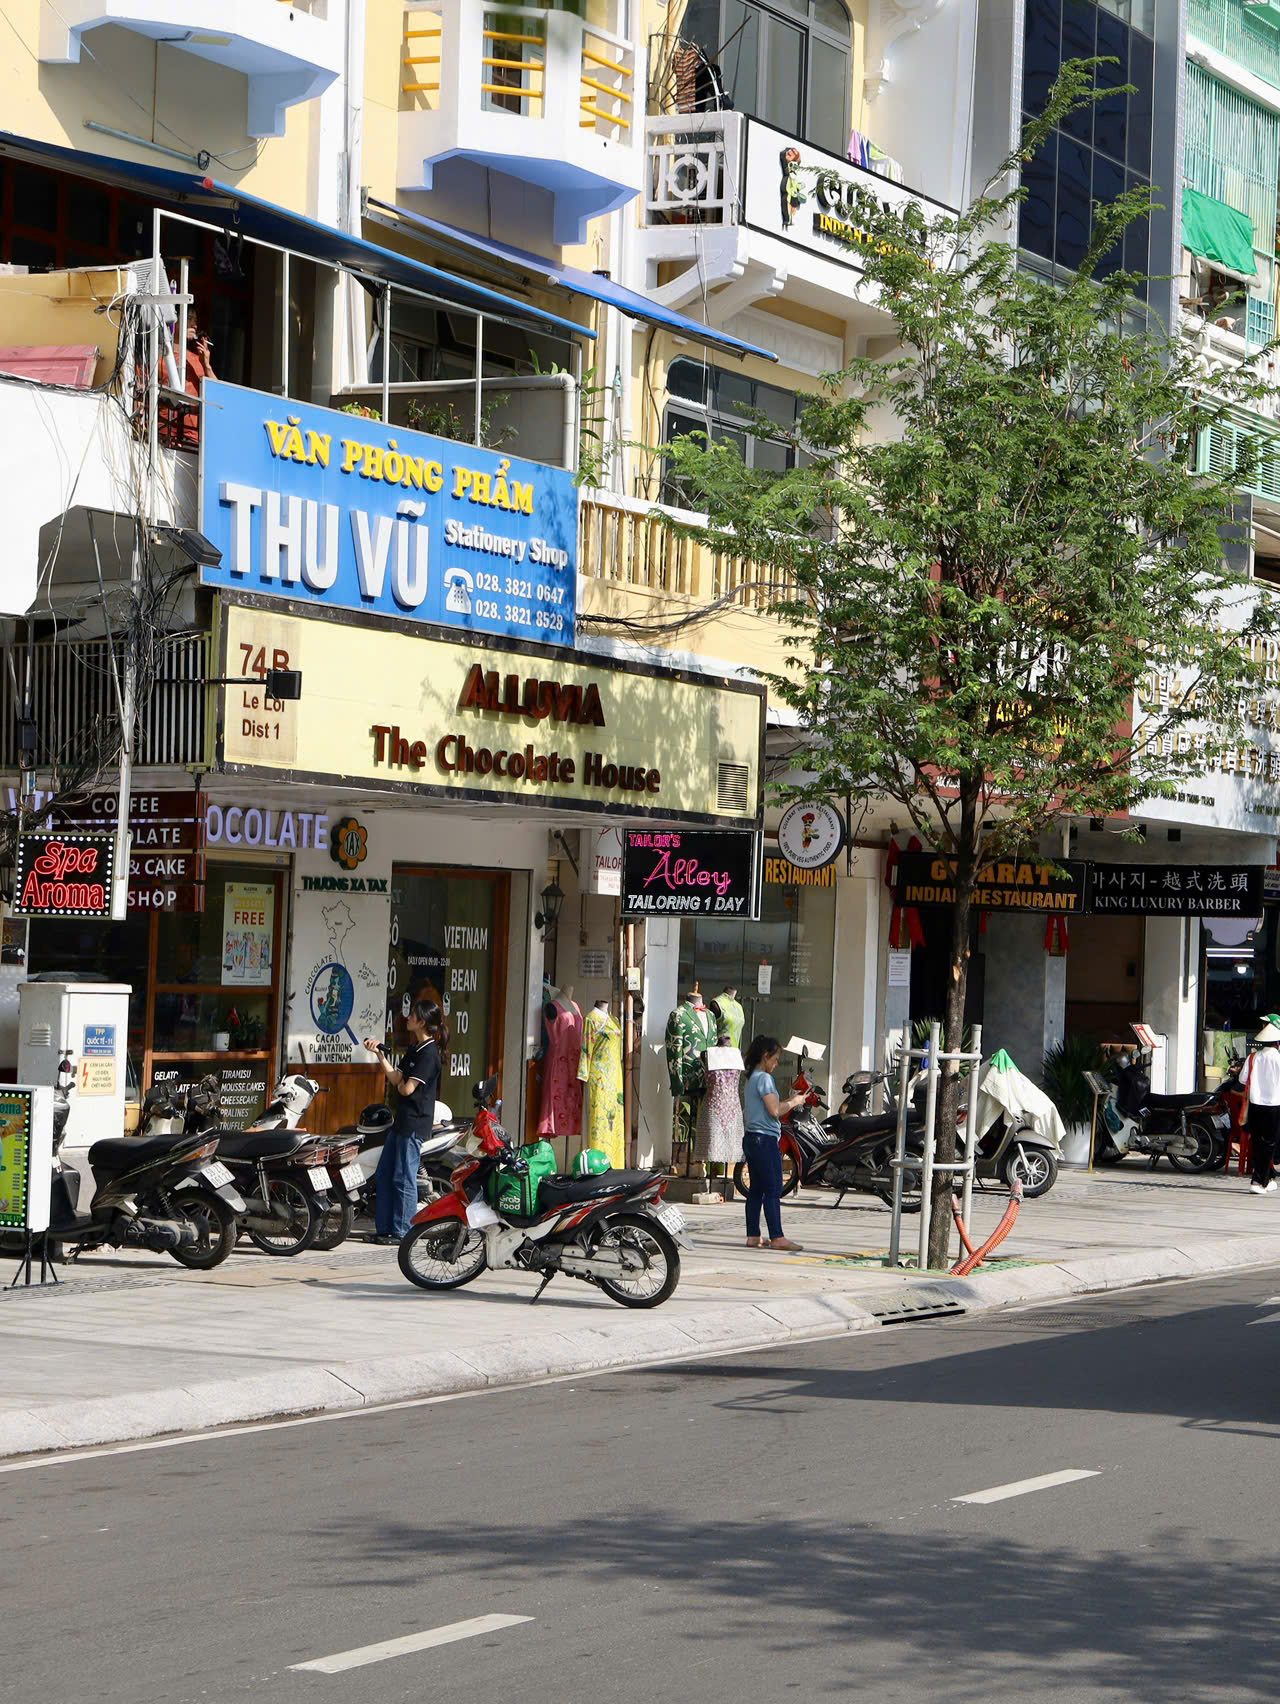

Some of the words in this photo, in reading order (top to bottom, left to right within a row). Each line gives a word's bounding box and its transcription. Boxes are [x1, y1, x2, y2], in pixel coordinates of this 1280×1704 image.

[818, 213, 863, 244] INDIAN
[264, 416, 331, 467] VĂN
[341, 440, 443, 494] PHÒNG
[452, 460, 535, 515] PHẨM
[219, 481, 340, 592] THU
[351, 500, 430, 608] VŨ
[445, 519, 527, 562] Stationery
[529, 537, 568, 571] Shop
[476, 571, 502, 593] 028.
[505, 577, 533, 599] 3821
[536, 583, 565, 605] 0647
[475, 599, 501, 620] 028.
[504, 604, 532, 627] 3821
[535, 612, 564, 632] 8528
[243, 690, 259, 709] Le
[242, 719, 269, 738] Dist
[274, 723, 280, 740] 1
[371, 725, 426, 768] The
[437, 735, 575, 784] Chocolate
[584, 752, 661, 794] House
[91, 797, 159, 814] COFEE
[628, 833, 681, 848] TAILOR'S
[34, 841, 98, 880] Spa
[145, 859, 185, 875] CAKE
[643, 848, 731, 895] Alley
[765, 858, 836, 887] RESTAURANT
[20, 871, 104, 910] Aroma
[366, 880, 388, 893] TAX
[627, 894, 701, 911] TAILORING
[704, 896, 711, 910] 1
[714, 897, 745, 912] DAY
[970, 889, 1077, 908] RESTAURANT
[1095, 896, 1128, 908] KING
[1131, 897, 1184, 909] LUXURY
[1188, 898, 1241, 910] BARBER
[234, 911, 264, 925] FREE
[444, 926, 488, 950] VIETNAM
[418, 957, 428, 965] OPEN
[305, 954, 332, 995] CHOCOLATE
[451, 969, 477, 991] BEAN
[456, 1011, 468, 1034] TO
[309, 1043, 352, 1053] PLANTATIONS
[315, 1034, 340, 1043] CACAO
[315, 1054, 322, 1062] IN
[325, 1054, 351, 1063] VIETNAM
[450, 1054, 470, 1076] BAR
[222, 1070, 251, 1079] TIRAMISU
[220, 1083, 246, 1091] MOUSSE
[246, 1082, 265, 1091] CAKES
[220, 1095, 258, 1104] CHEESECAKE
[220, 1108, 249, 1117] PRALINES
[220, 1121, 244, 1130] TRUFFLE
[500, 1202, 520, 1210] Food
